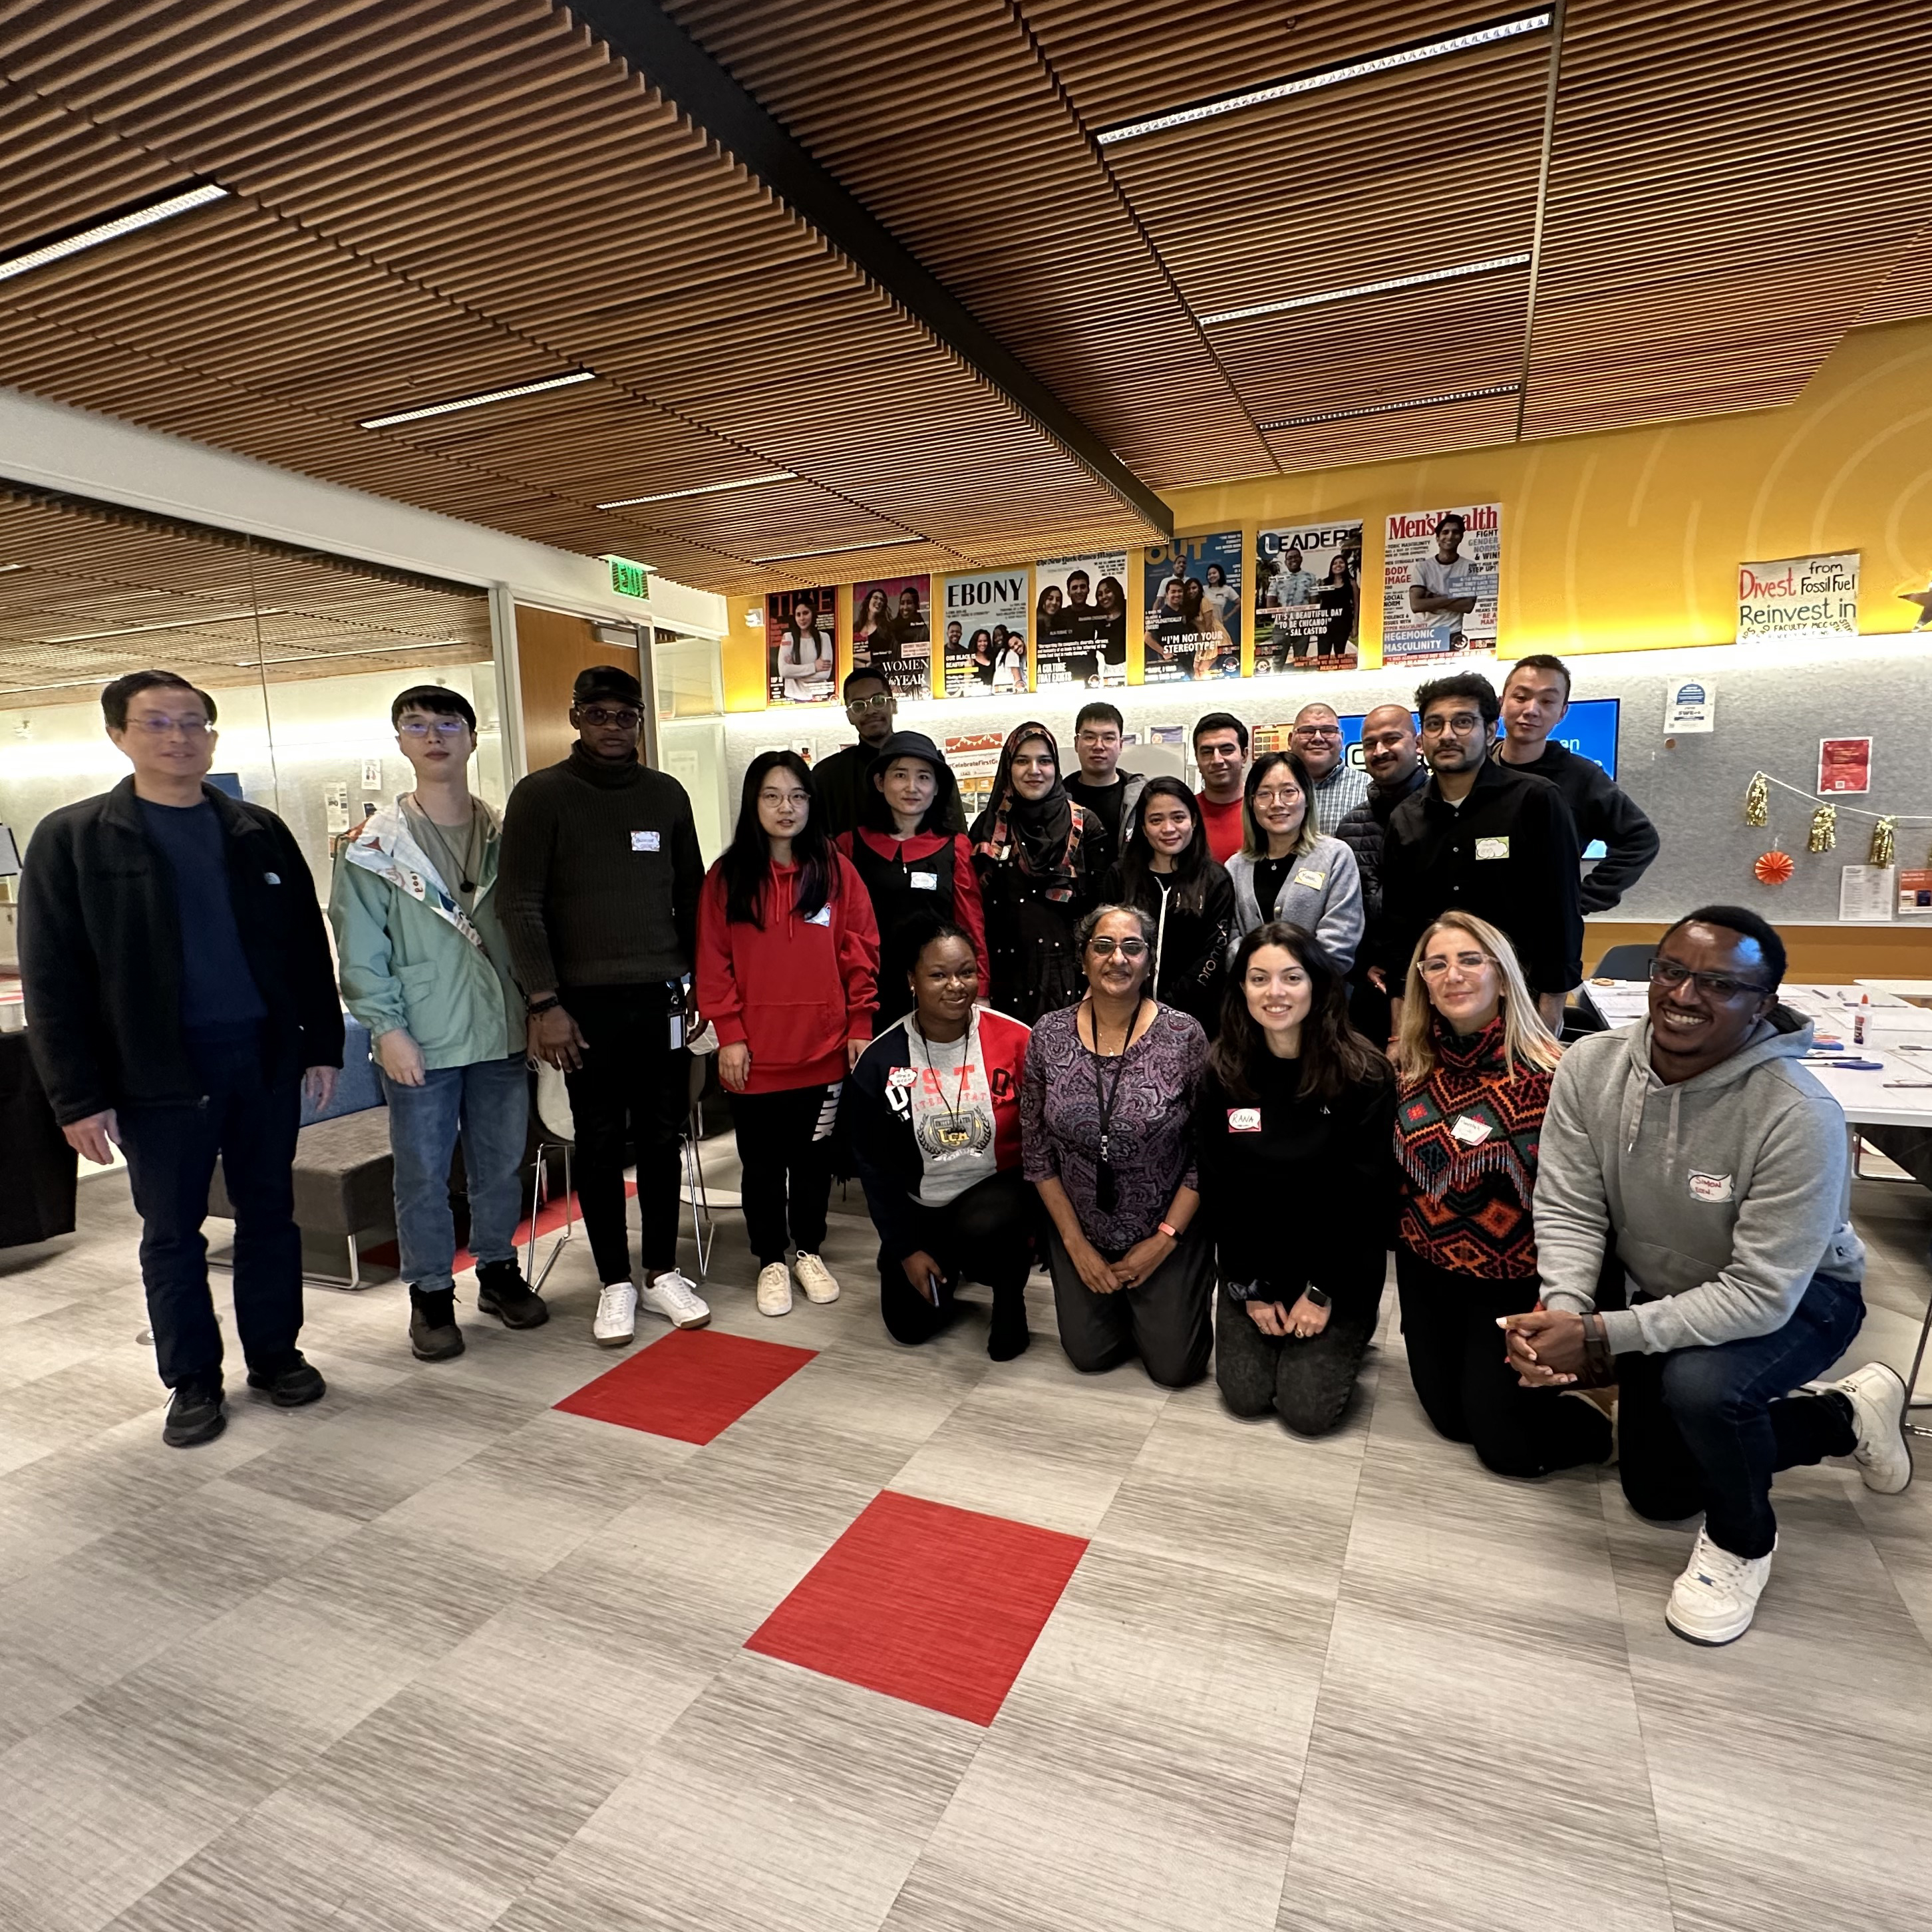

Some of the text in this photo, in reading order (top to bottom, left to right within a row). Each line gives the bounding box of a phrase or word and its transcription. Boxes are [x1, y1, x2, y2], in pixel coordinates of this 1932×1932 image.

[1388, 514, 1436, 540] Men's
[1436, 506, 1498, 532] Halth
[1476, 529, 1498, 538] FIGHT
[1468, 537, 1498, 546] GENDER
[1144, 538, 1207, 565] OUT
[1385, 565, 1408, 576] BODY
[1809, 562, 1843, 574] from
[617, 564, 643, 594] EXIT
[1385, 574, 1412, 585] IMAGE
[1740, 567, 1796, 600] Divest
[1801, 574, 1855, 595] Fossil Fuel
[948, 577, 1023, 607] EBONY
[772, 589, 832, 617] TIE
[1295, 610, 1329, 619] BEAUTIFUL
[1740, 597, 1856, 625] Reinvest in
[1303, 626, 1327, 635] CASTRO
[1774, 623, 1807, 632] FACULTY
[1182, 633, 1199, 643] NOT
[1201, 631, 1223, 641] YOUR
[1384, 629, 1435, 641] HEGEMONIC
[1384, 640, 1442, 653] MASCULINITY
[882, 659, 929, 672] WOMEN
[895, 673, 926, 686] YEAR
[1037, 673, 1051, 683] THAT
[812, 1082, 844, 1141] PINK
[1232, 1114, 1254, 1124] RANA
[1694, 1176, 1722, 1188] SIMON
